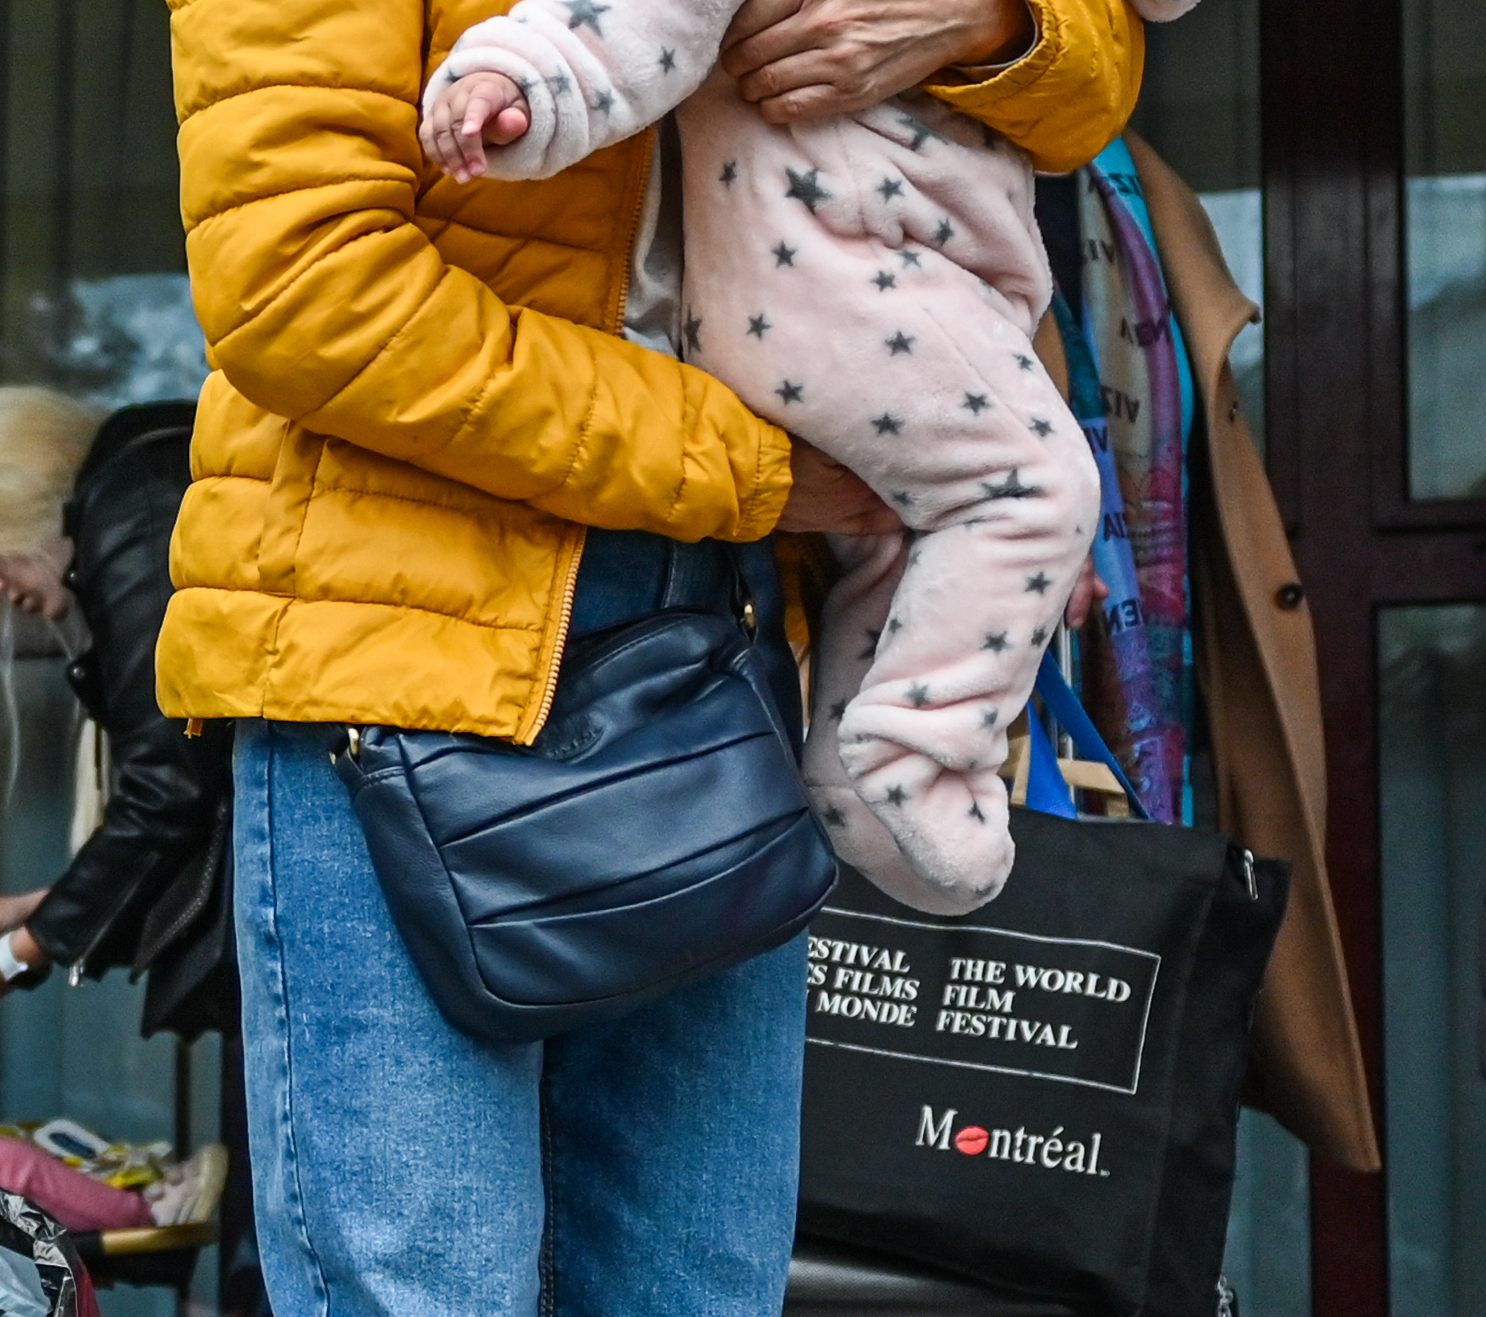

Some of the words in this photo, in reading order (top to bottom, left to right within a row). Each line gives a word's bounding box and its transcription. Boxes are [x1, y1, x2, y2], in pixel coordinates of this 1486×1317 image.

[807, 936, 911, 974] ESTIVAL
[833, 967, 920, 1001] FILMS
[942, 984, 1016, 1013] FILM
[949, 957, 1007, 985] THE
[1014, 964, 1132, 1003] WORLD
[815, 989, 918, 1028] MONDE
[935, 1009, 1079, 1050] FESTIVAL
